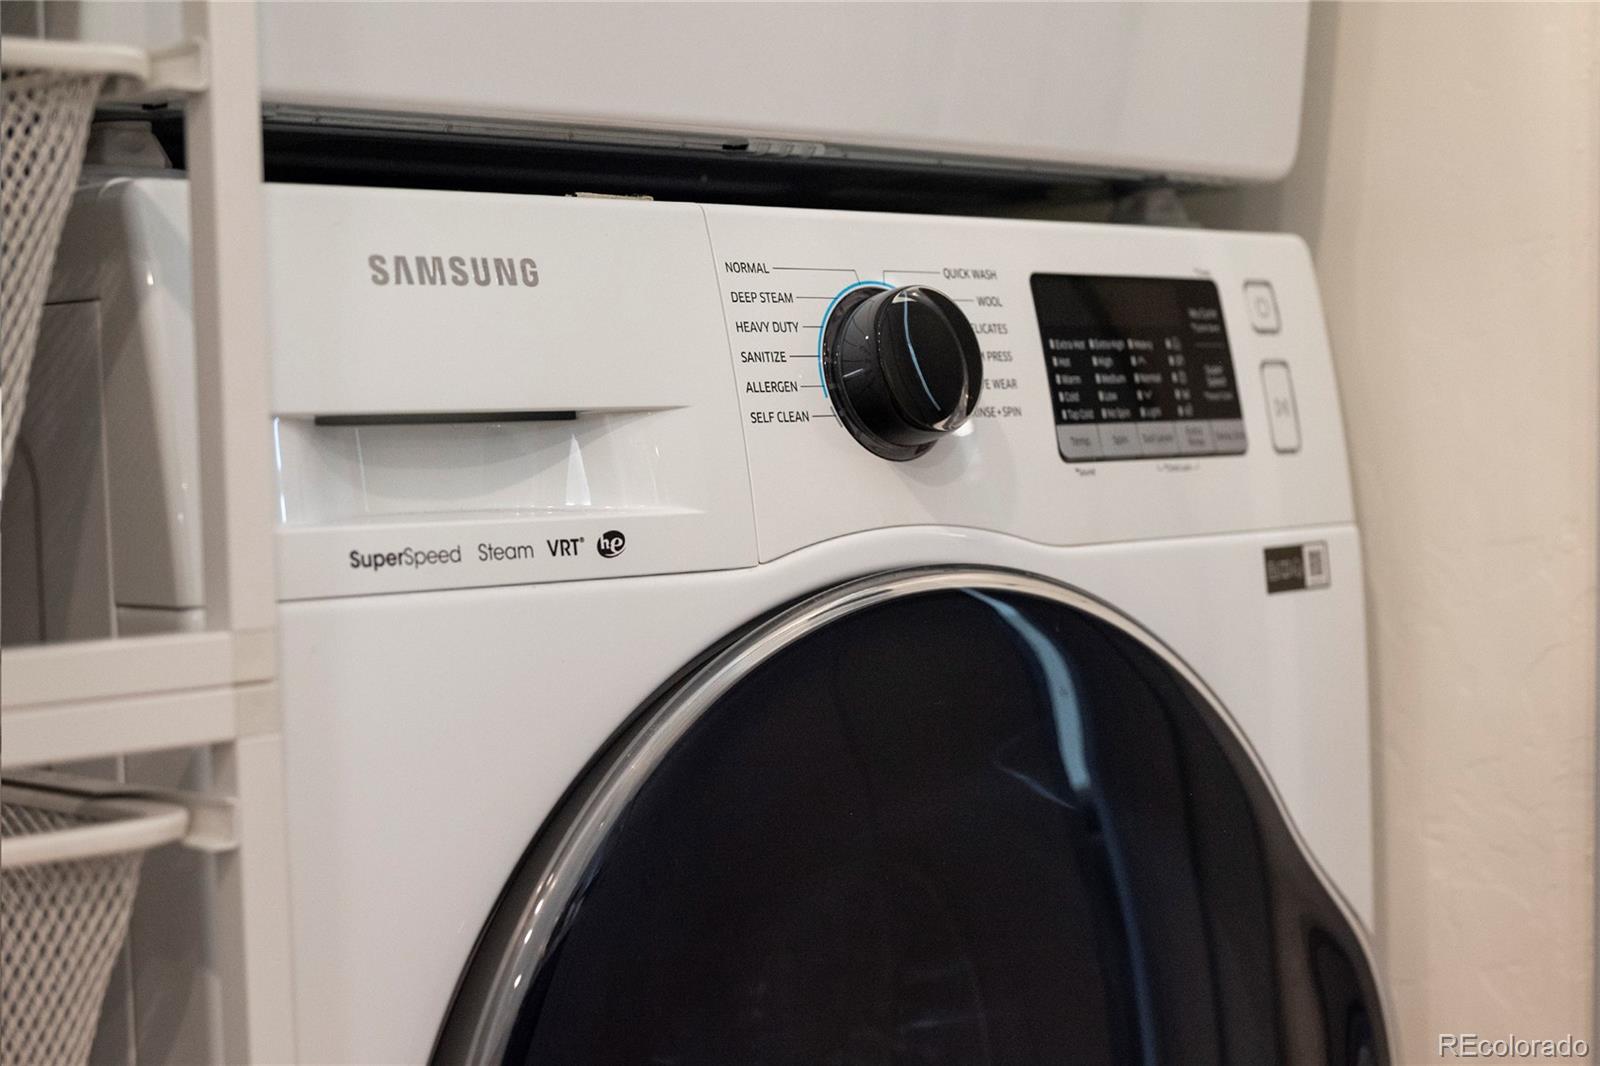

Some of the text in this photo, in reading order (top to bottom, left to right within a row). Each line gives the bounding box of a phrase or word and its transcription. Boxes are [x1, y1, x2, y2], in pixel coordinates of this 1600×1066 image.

[368, 254, 540, 288] SAMSUNG
[724, 261, 770, 274] NORMAL
[943, 267, 997, 280] QUICK WASH
[730, 291, 794, 304] DEEP STEAM
[976, 296, 1003, 307] WOOL
[735, 321, 799, 333] HEAVY DUTY
[740, 351, 788, 363] SANITIZE
[986, 351, 1013, 363] PRESS
[746, 381, 799, 393] ALLERGEN
[991, 378, 1018, 390] WEAR
[750, 411, 810, 424] SELF CLEAN
[349, 546, 462, 571] SuperSpeed
[478, 542, 535, 562] Steam
